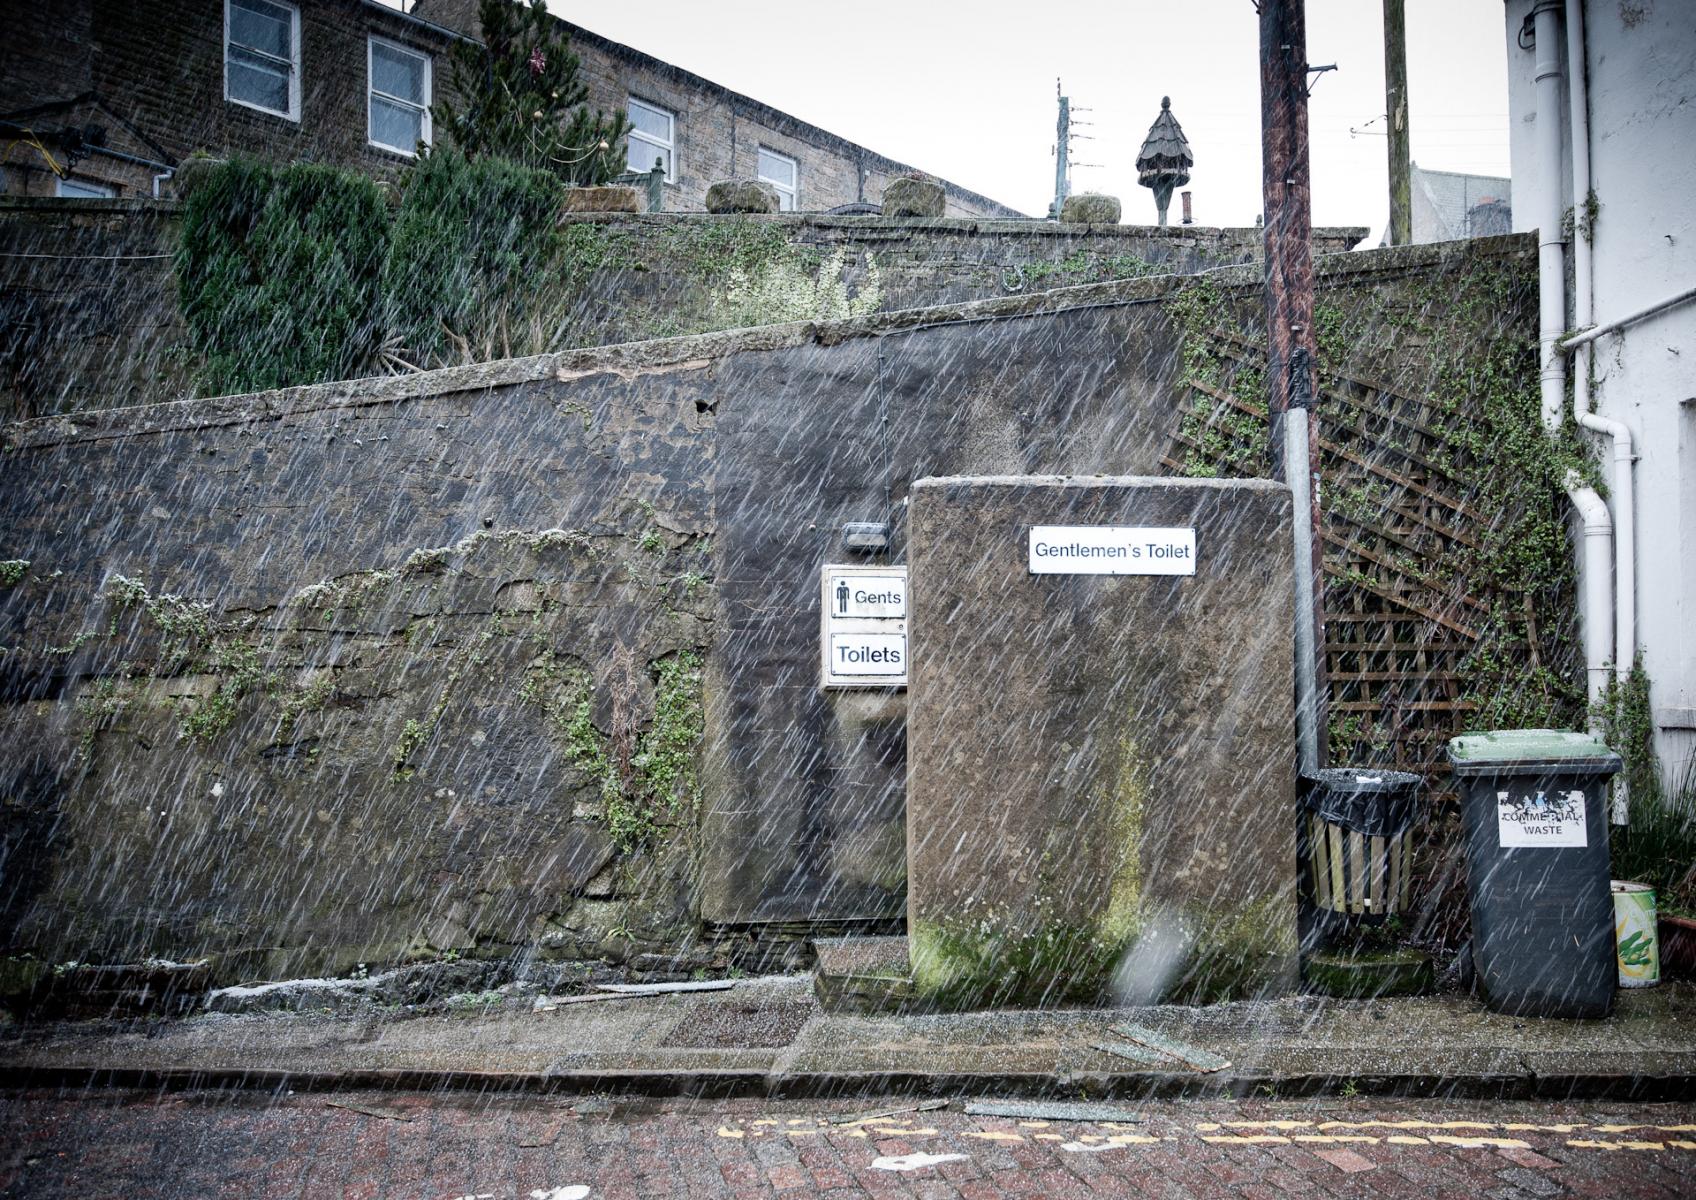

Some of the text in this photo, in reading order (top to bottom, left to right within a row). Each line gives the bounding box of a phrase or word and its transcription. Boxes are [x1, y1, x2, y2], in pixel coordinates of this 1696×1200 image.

[1035, 542, 1190, 559] Gentlemen's Toilet
[855, 590, 902, 604] Gents
[836, 645, 901, 663] Toilets
[1502, 812, 1579, 822] COMMEIAL
[1524, 826, 1563, 835] WASTE
